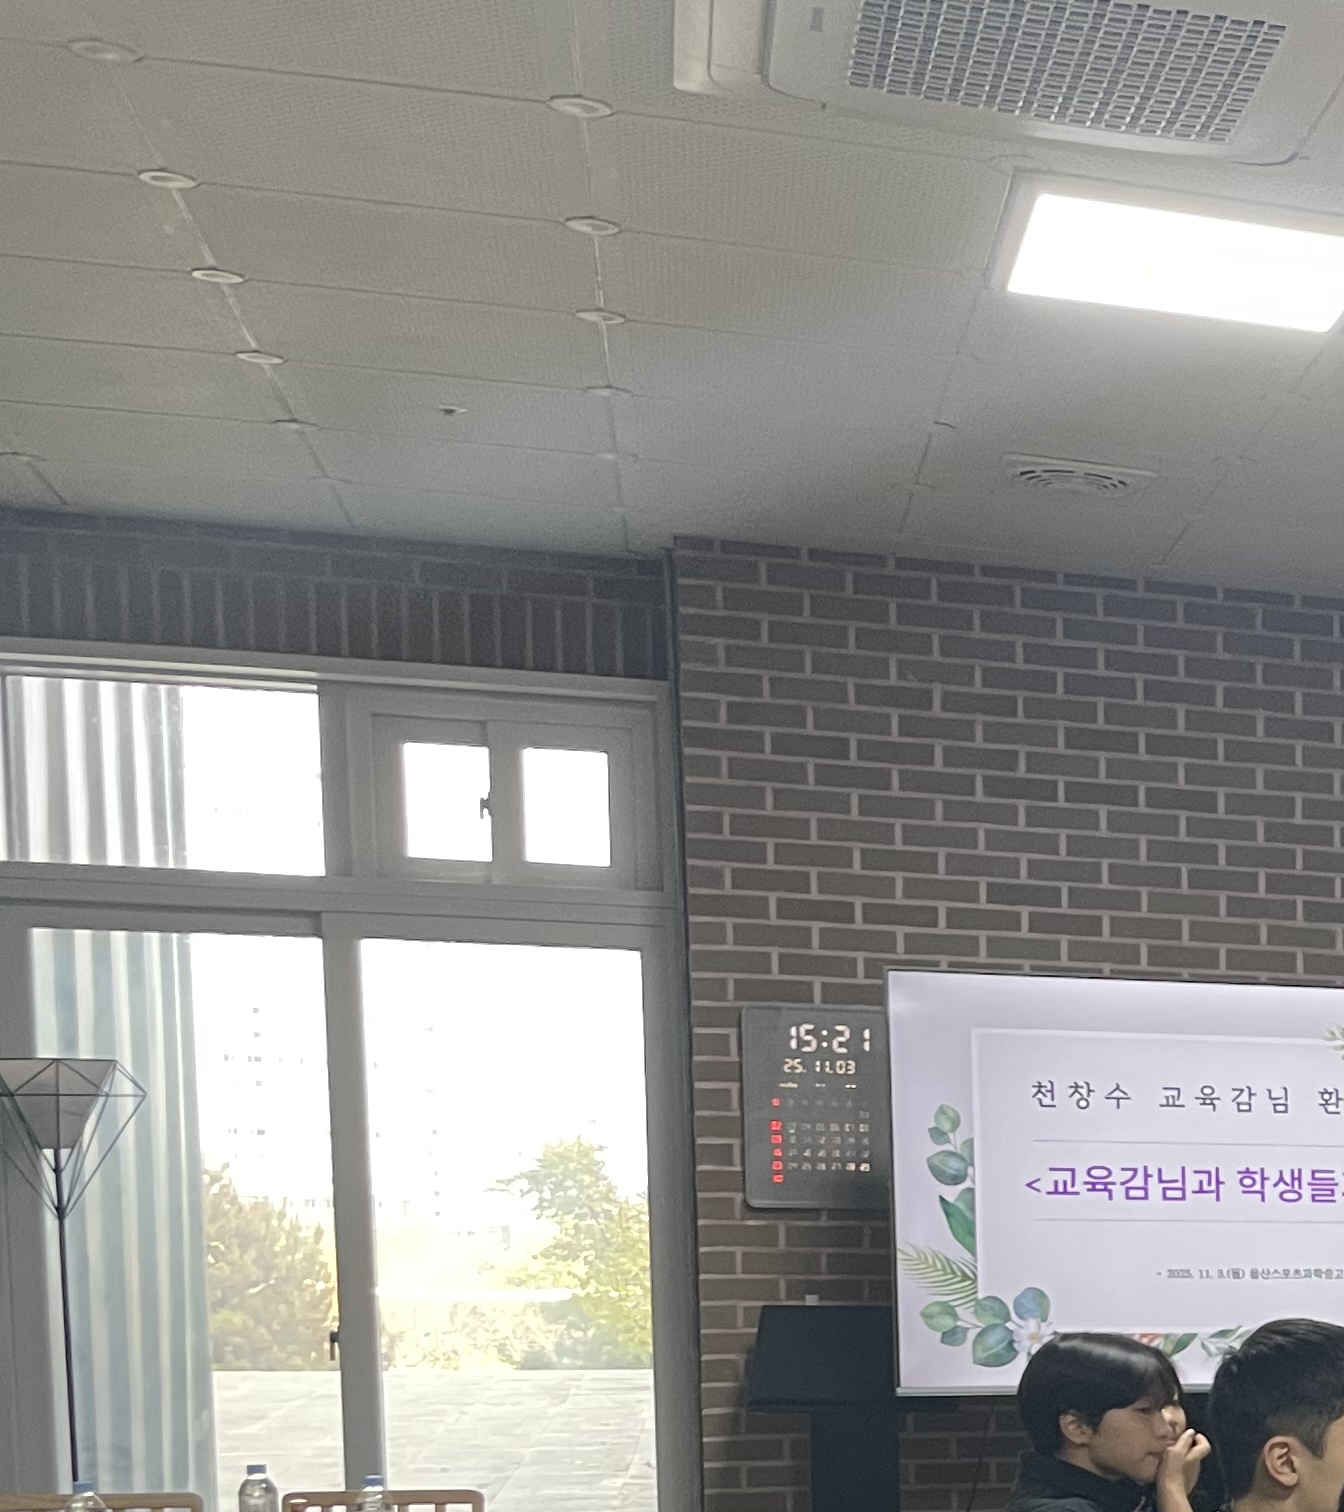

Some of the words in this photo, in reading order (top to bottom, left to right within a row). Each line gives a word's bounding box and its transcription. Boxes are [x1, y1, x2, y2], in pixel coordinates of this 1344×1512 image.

[789, 1023, 871, 1053] 15:21
[1031, 1080, 1132, 1110] 천창수
[1158, 1084, 1291, 1115] 교육감님
[1025, 1165, 1226, 1203] <교육감님과
